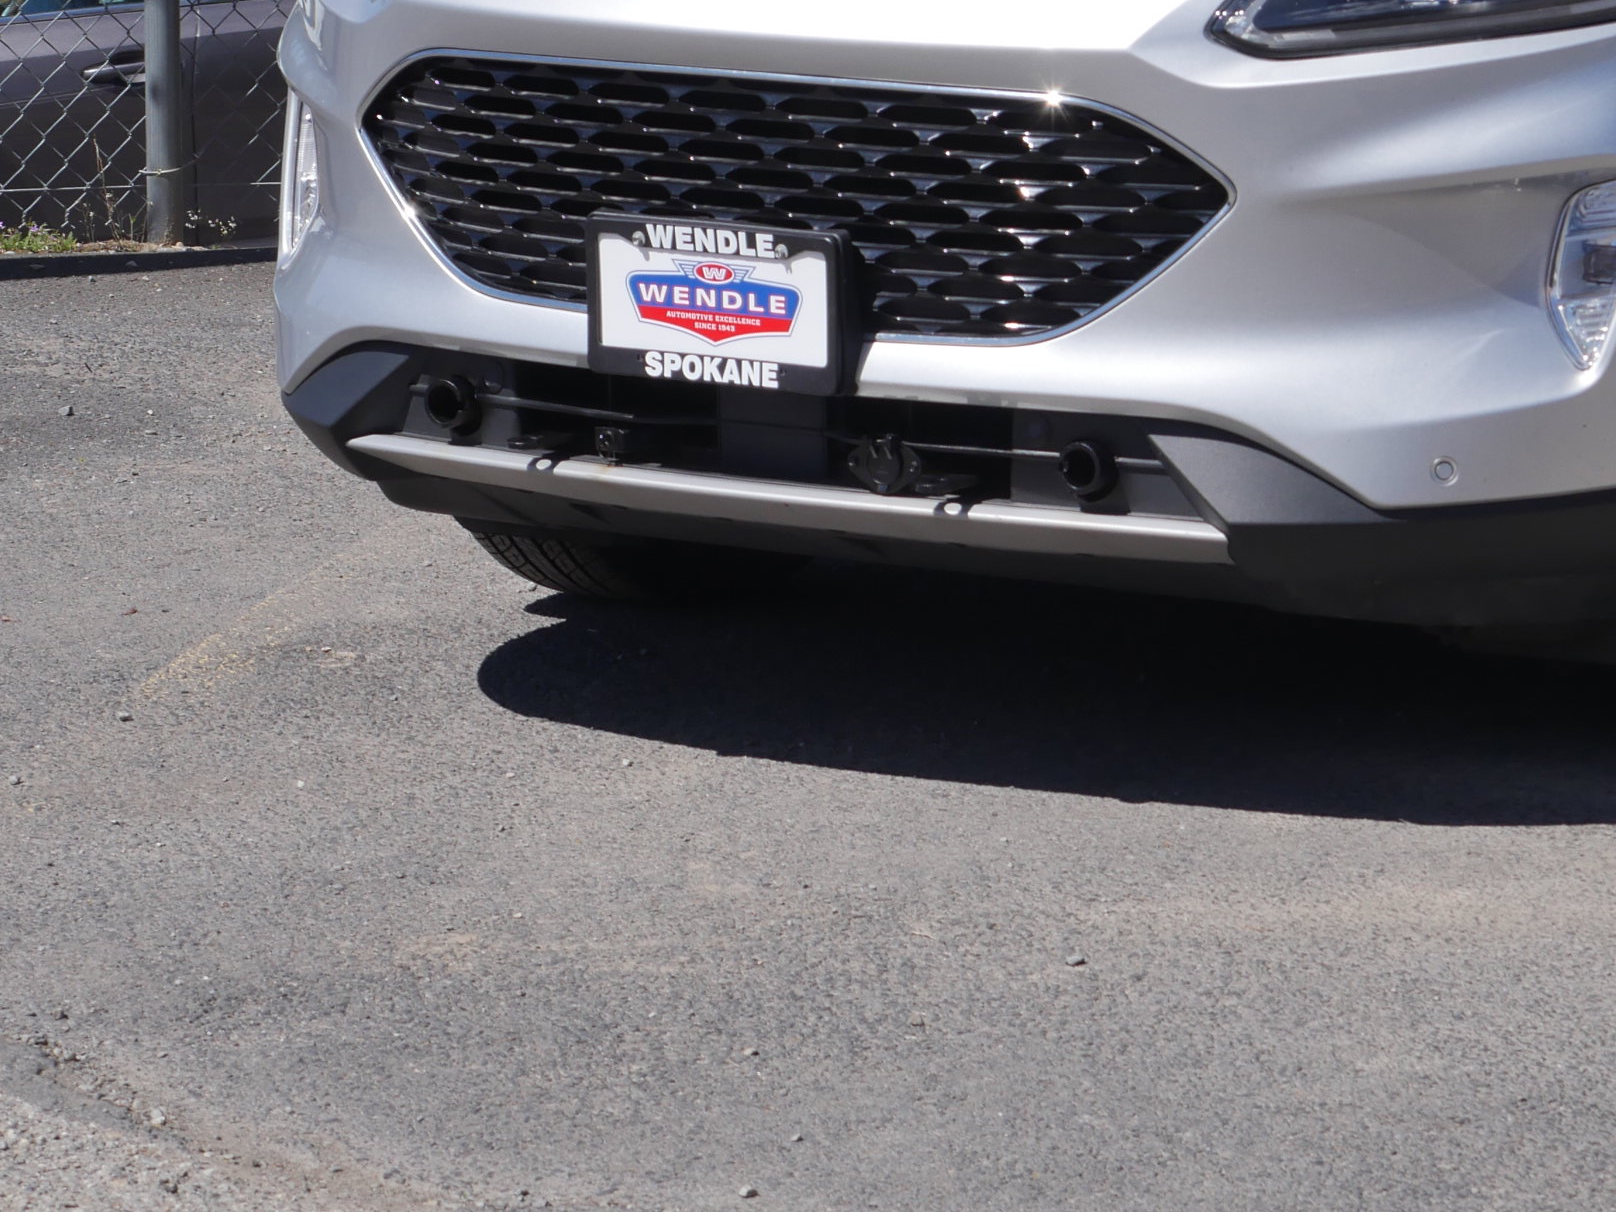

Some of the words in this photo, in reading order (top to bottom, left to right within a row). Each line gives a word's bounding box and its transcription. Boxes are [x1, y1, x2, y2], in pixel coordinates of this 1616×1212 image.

[646, 224, 775, 258] WENDLE
[702, 266, 727, 280] W
[638, 283, 786, 314] WENDLE
[666, 310, 713, 322] AUTOMOTIVE
[715, 314, 761, 326] EXCELLENCE
[694, 321, 717, 330] SINCE
[718, 324, 736, 332] 1943
[645, 351, 779, 388] SPOKANE
